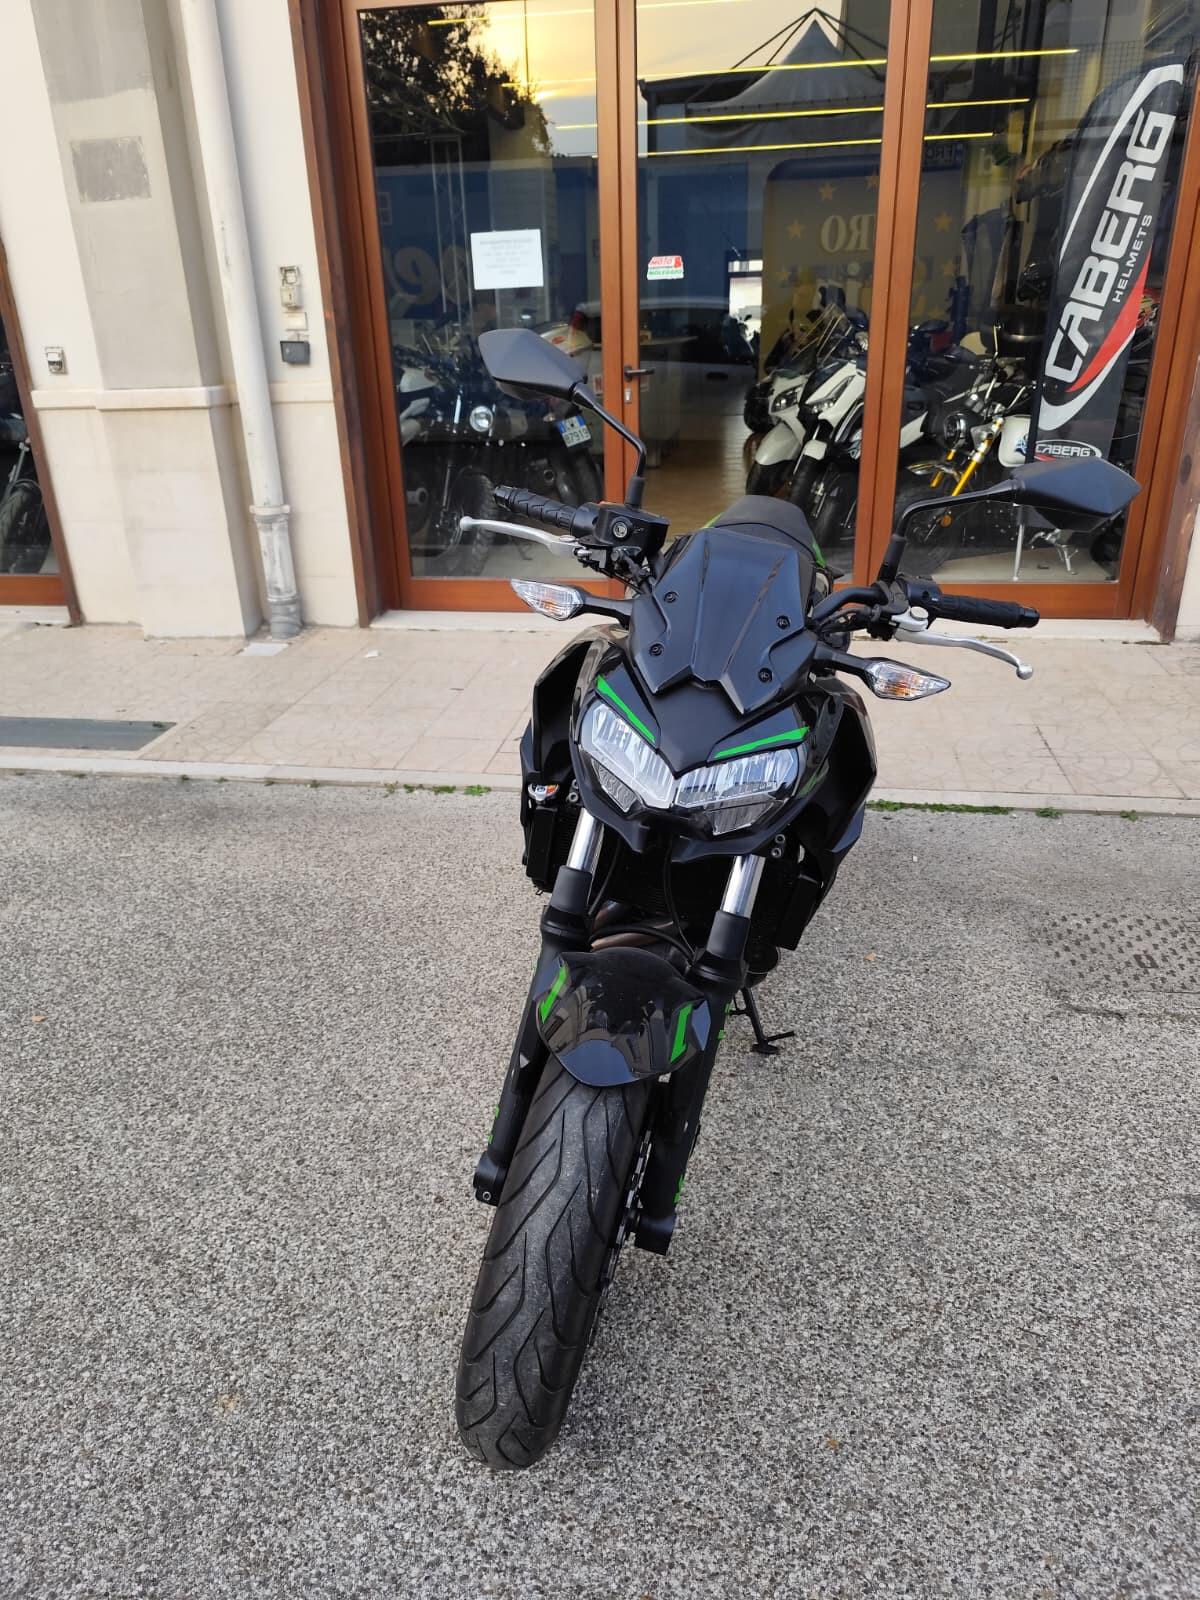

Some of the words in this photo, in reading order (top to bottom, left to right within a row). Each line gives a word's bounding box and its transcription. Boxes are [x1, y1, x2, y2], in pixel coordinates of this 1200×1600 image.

[1044, 107, 1176, 383] CABERG
[1112, 214, 1152, 302] HELMETS
[1035, 443, 1091, 457] CABERG
